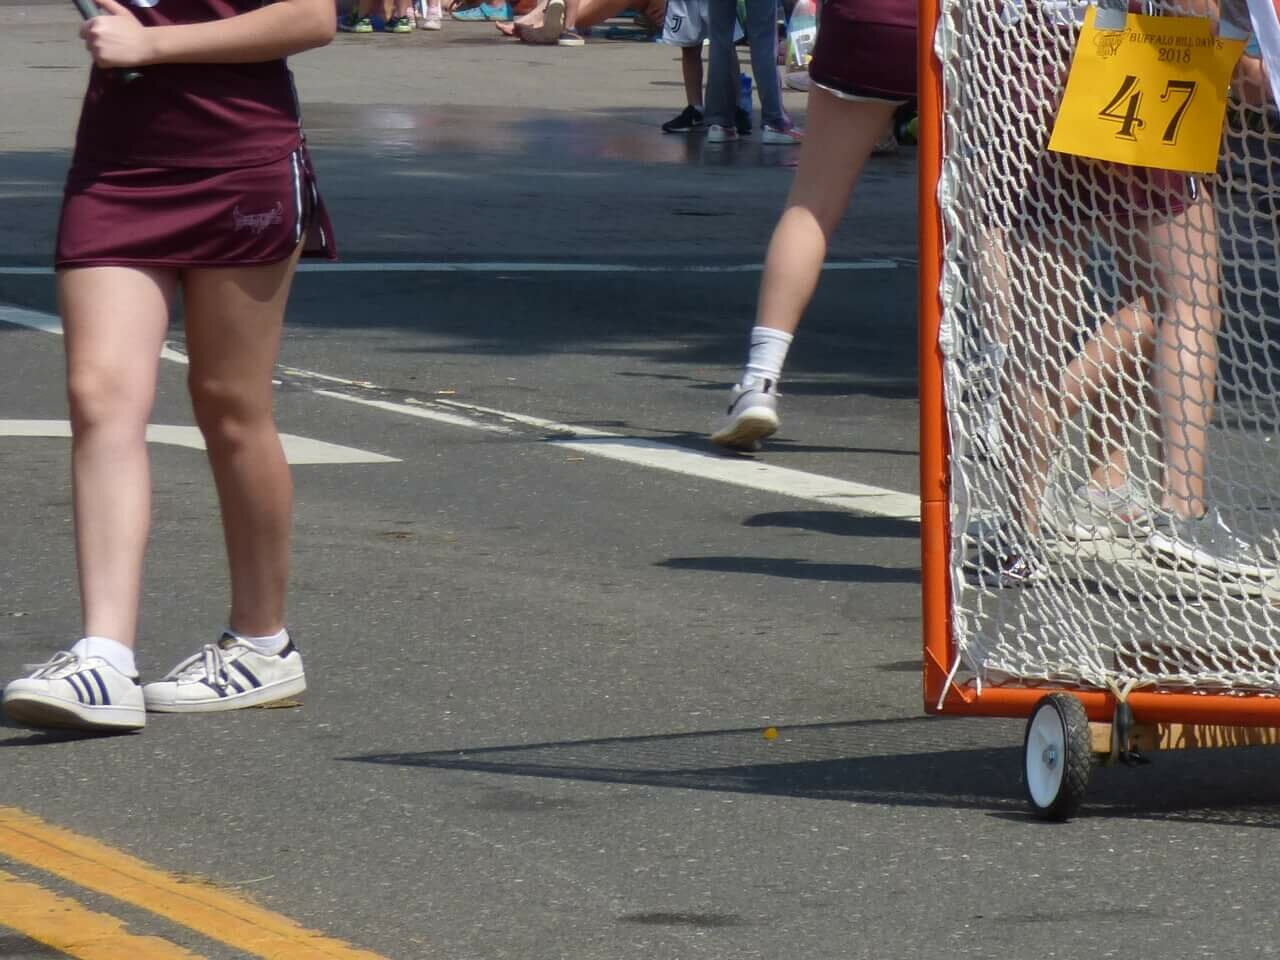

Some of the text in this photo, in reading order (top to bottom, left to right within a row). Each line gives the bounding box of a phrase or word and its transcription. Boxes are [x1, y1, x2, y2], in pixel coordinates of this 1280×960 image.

[1129, 32, 1174, 46] BUFFALO
[1157, 47, 1192, 64] 2018
[1098, 75, 1199, 146] 47
